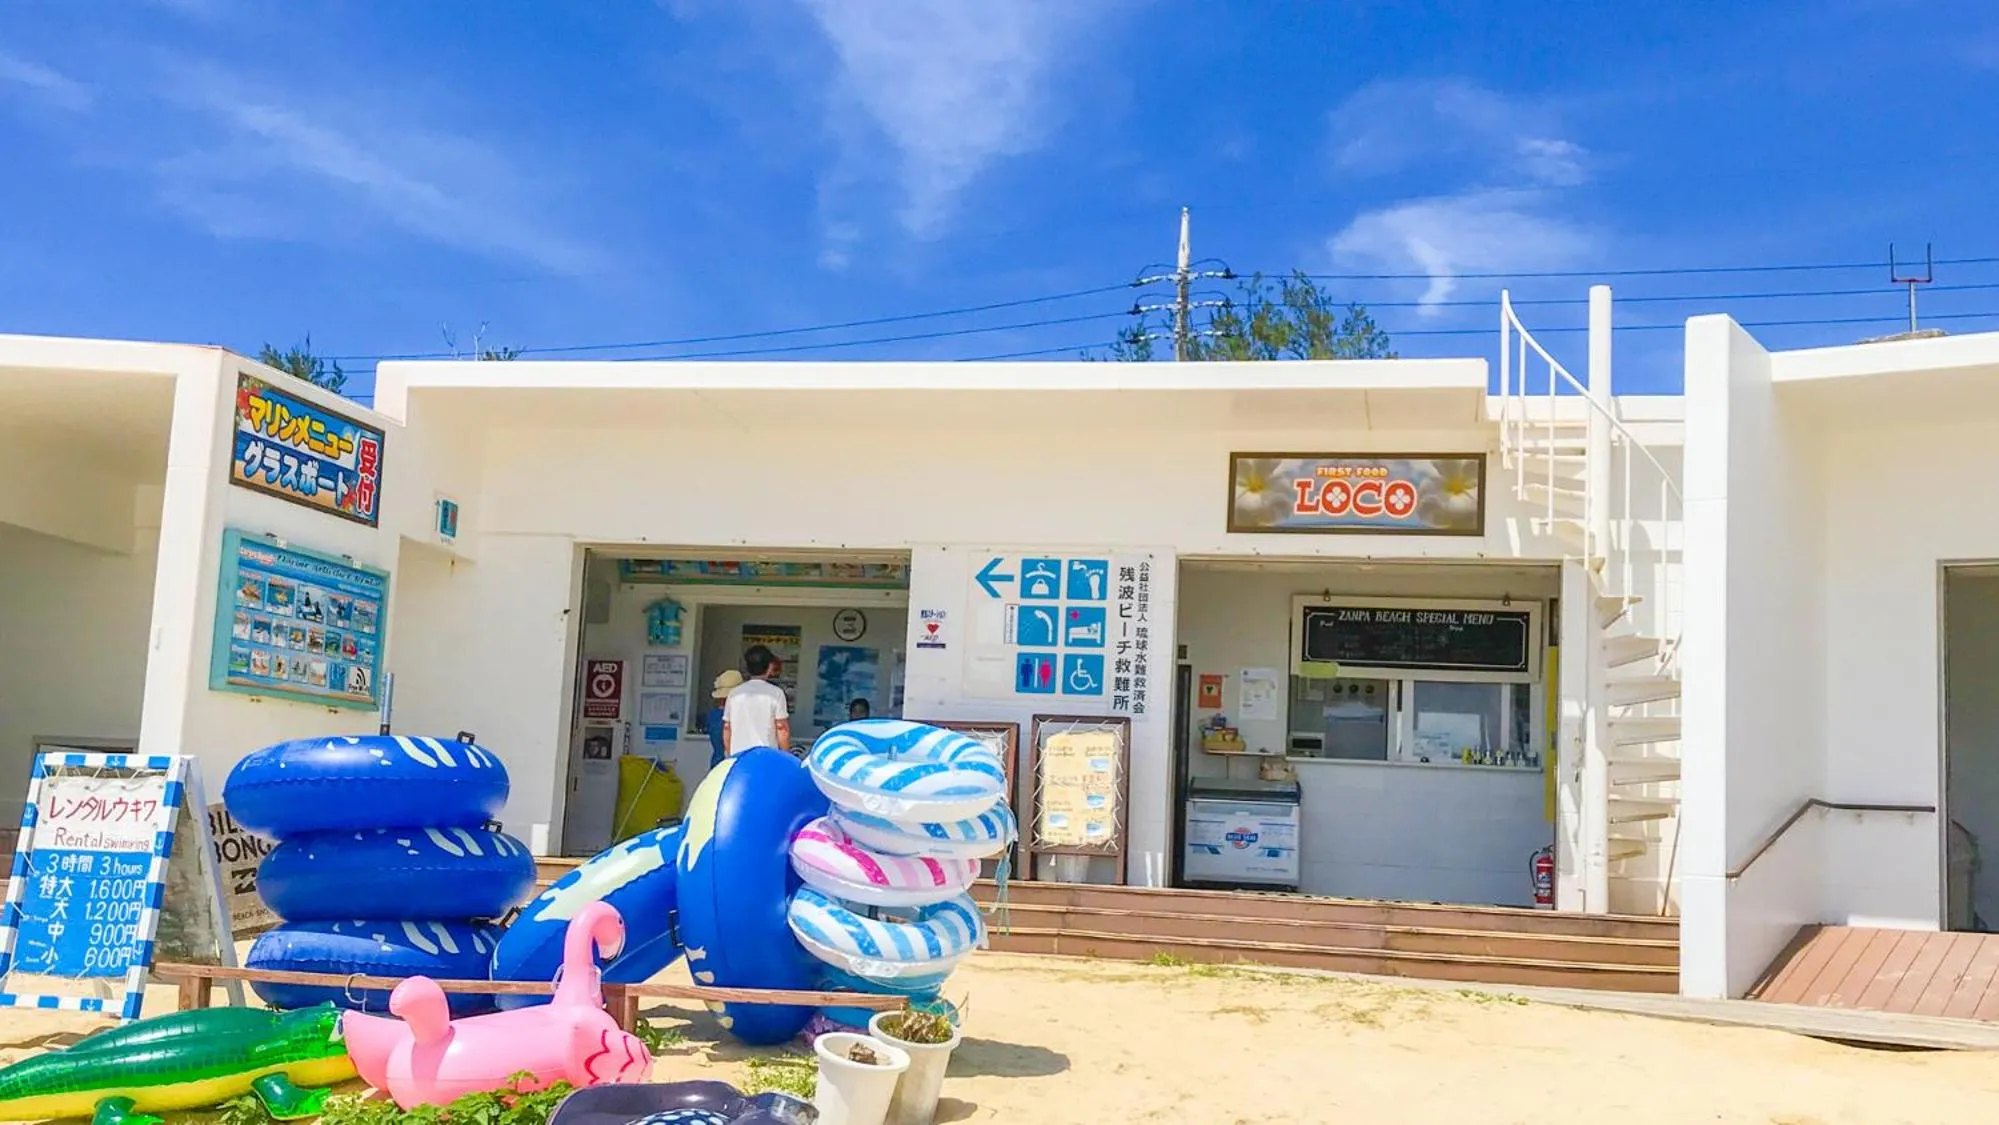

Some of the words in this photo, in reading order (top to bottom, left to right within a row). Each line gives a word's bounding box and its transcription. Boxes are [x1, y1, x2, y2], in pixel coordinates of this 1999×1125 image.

[248, 394, 354, 460] マリンメニュー
[243, 440, 350, 507] グラスボート
[356, 438, 379, 514] 受付
[1316, 466, 1351, 477] FIRST
[1355, 467, 1389, 477] FOOD
[1294, 479, 1417, 517] LOCO
[1136, 562, 1150, 622] 公益社団法人
[1338, 610, 1371, 622] ZANPA
[1376, 611, 1411, 623] BEACH
[1416, 612, 1459, 625] SPECIAL
[1463, 614, 1495, 625] MENU
[1113, 566, 1135, 711] 残波ビーチ救難所
[593, 663, 618, 673] AED
[49, 796, 157, 821] レンタルウキワ
[54, 827, 103, 848] Rental
[113, 856, 144, 875] hours
[39, 874, 75, 899] 特大
[50, 898, 70, 919] 大
[48, 921, 65, 944] 中
[89, 923, 137, 946] 900円
[40, 946, 59, 964] 小
[84, 946, 131, 968] 600円
